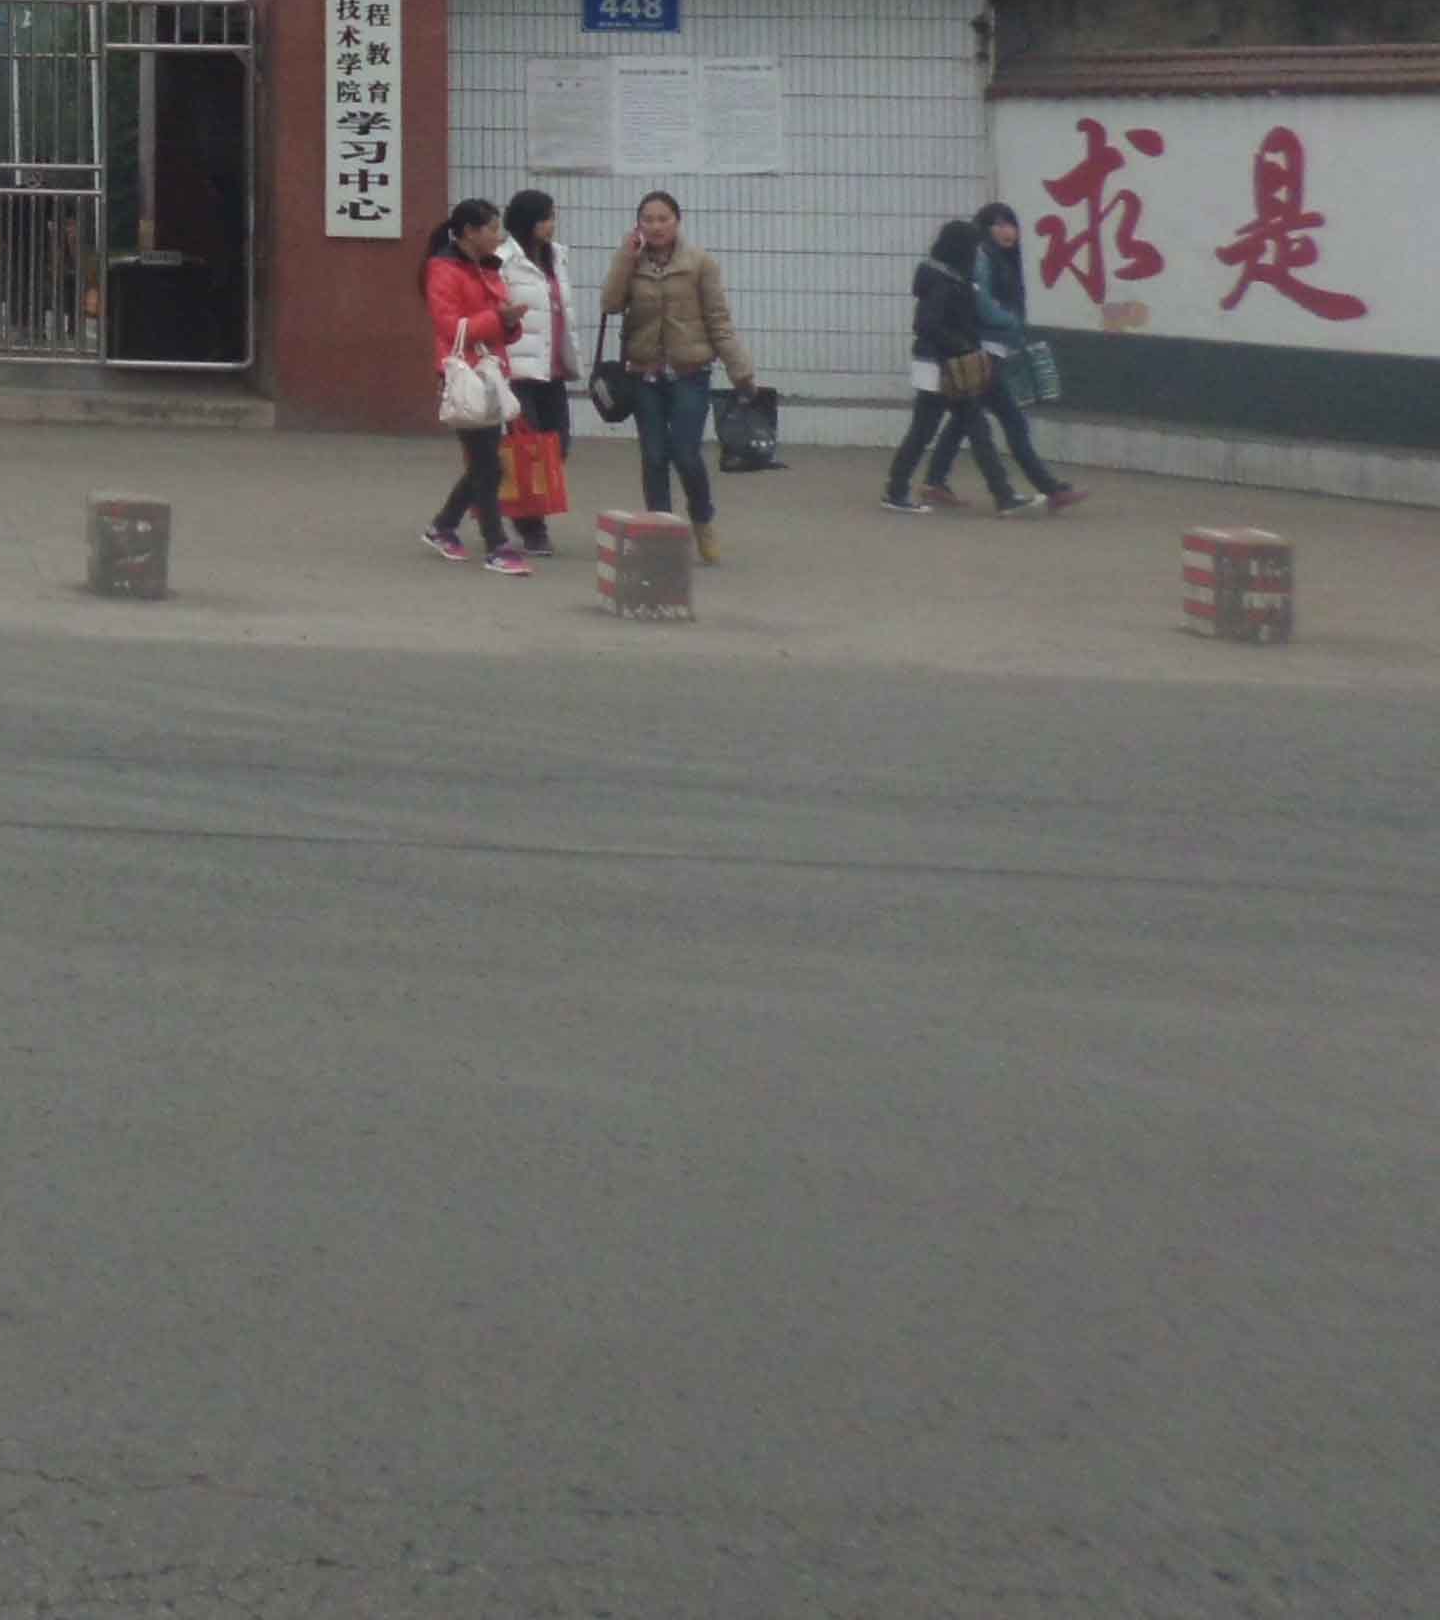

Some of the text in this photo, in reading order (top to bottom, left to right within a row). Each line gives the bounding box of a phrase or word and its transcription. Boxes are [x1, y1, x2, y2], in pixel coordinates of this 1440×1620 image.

[336, 111, 391, 221] 学习中心
[1036, 118, 1368, 321] 求是
